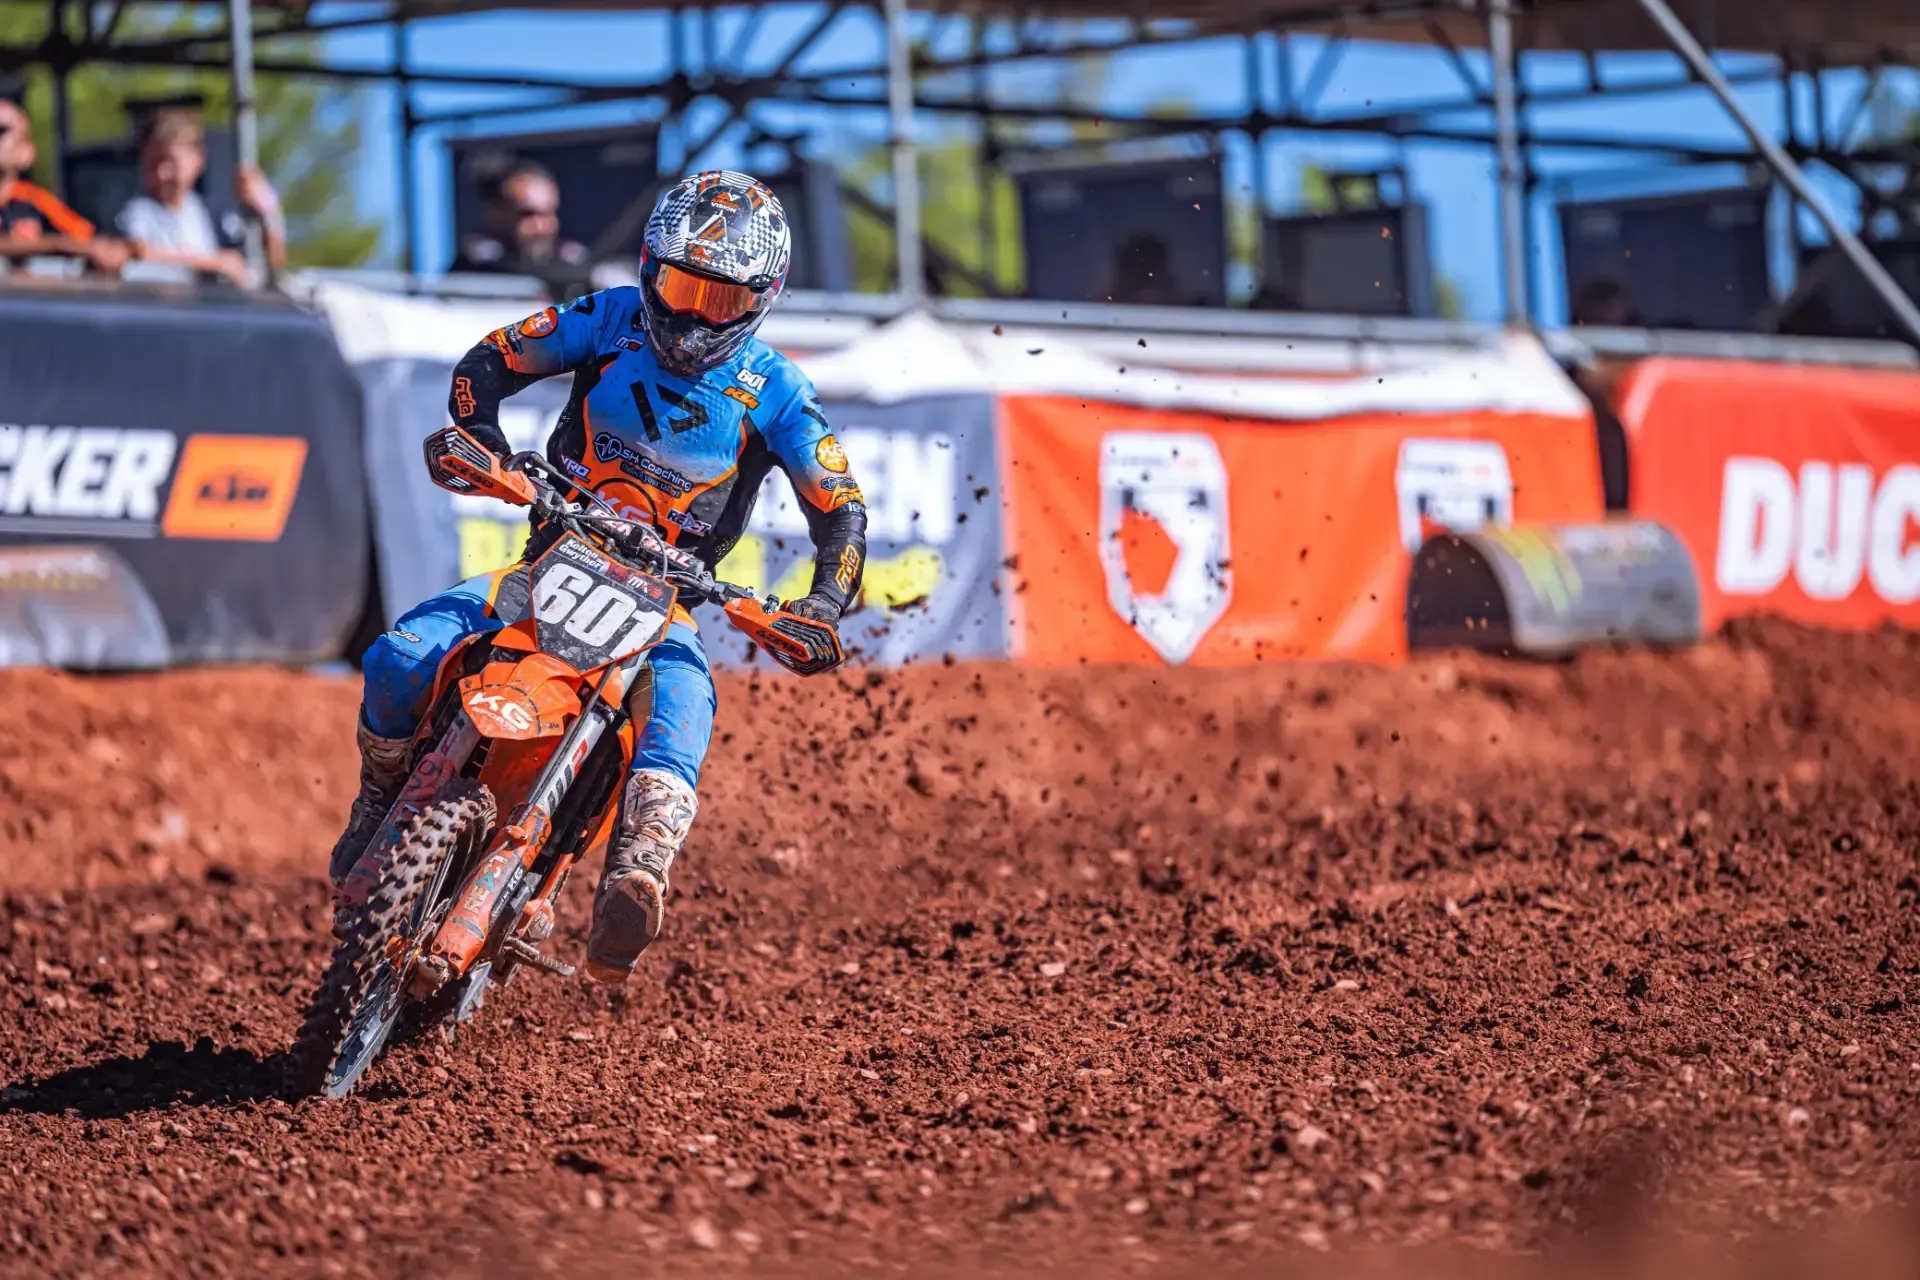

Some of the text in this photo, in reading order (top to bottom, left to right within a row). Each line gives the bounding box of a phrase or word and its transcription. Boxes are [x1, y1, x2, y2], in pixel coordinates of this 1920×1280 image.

[736, 367, 769, 392] 601
[640, 458, 692, 492] Coaching
[565, 538, 600, 560] Kelton
[532, 562, 667, 660] 601
[468, 691, 534, 731] KG
